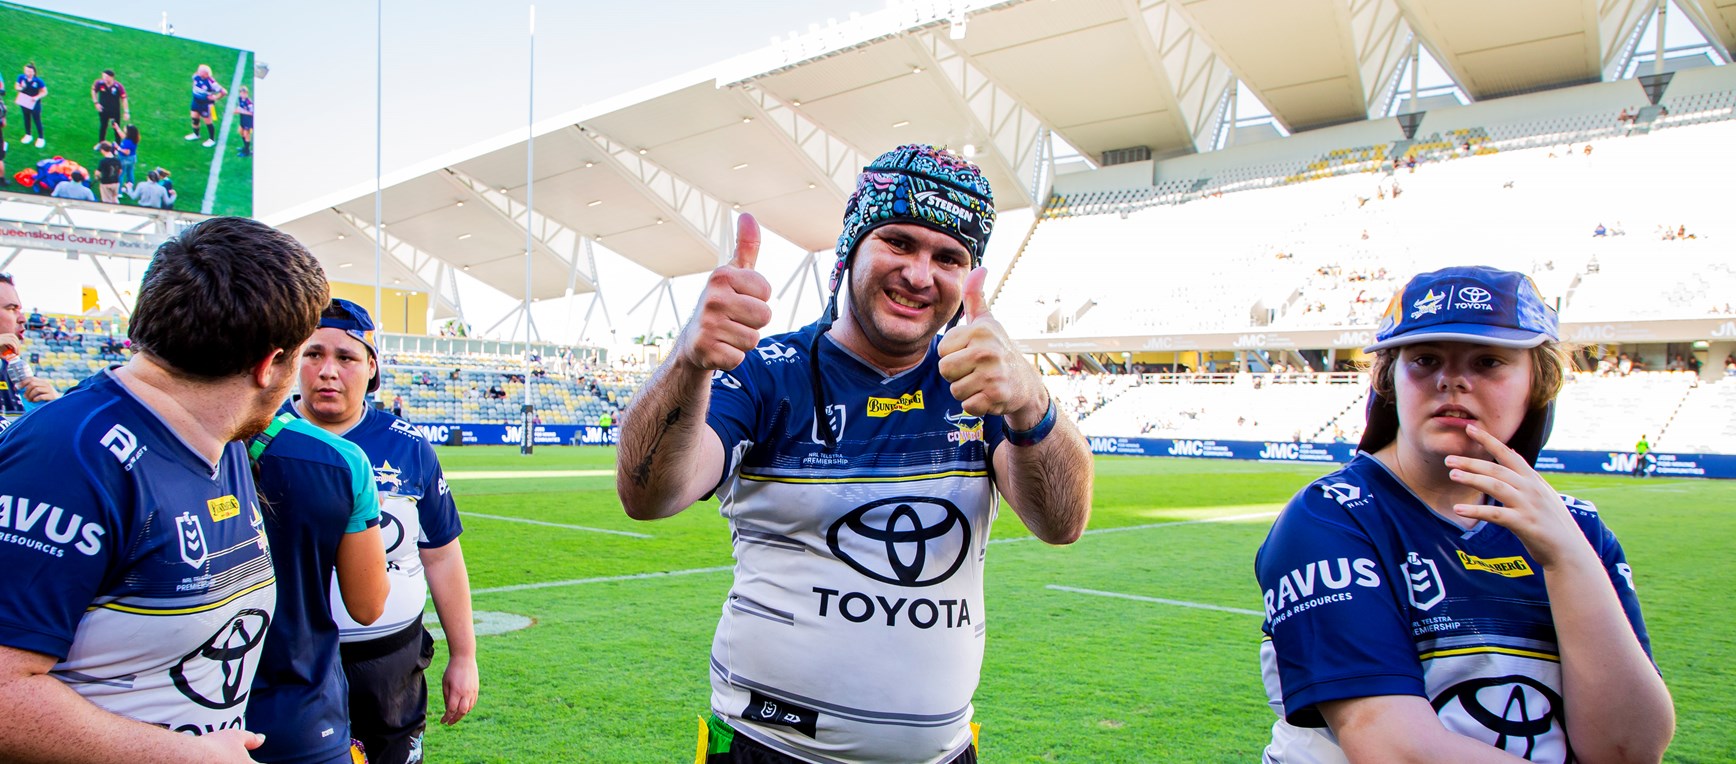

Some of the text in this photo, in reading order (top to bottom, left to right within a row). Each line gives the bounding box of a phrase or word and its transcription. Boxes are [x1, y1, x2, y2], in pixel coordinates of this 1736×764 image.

[926, 194, 975, 223] STEEDEN
[0, 228, 65, 241] ueensland
[68, 233, 116, 248] Country
[1455, 302, 1493, 311] TOYOTA
[1333, 332, 1370, 345] JMC
[1571, 325, 1615, 340] JMC
[1143, 337, 1172, 348] JMC
[1233, 334, 1266, 347] JMC
[1168, 440, 1203, 456] JMC
[1259, 442, 1299, 459] JMC
[812, 586, 971, 629] TOYOTA
[1287, 609, 1293, 618] &
[1294, 592, 1353, 613] RESOURCES
[1422, 616, 1452, 624] TELSTRA
[1413, 622, 1461, 636] EMIERSHIP
